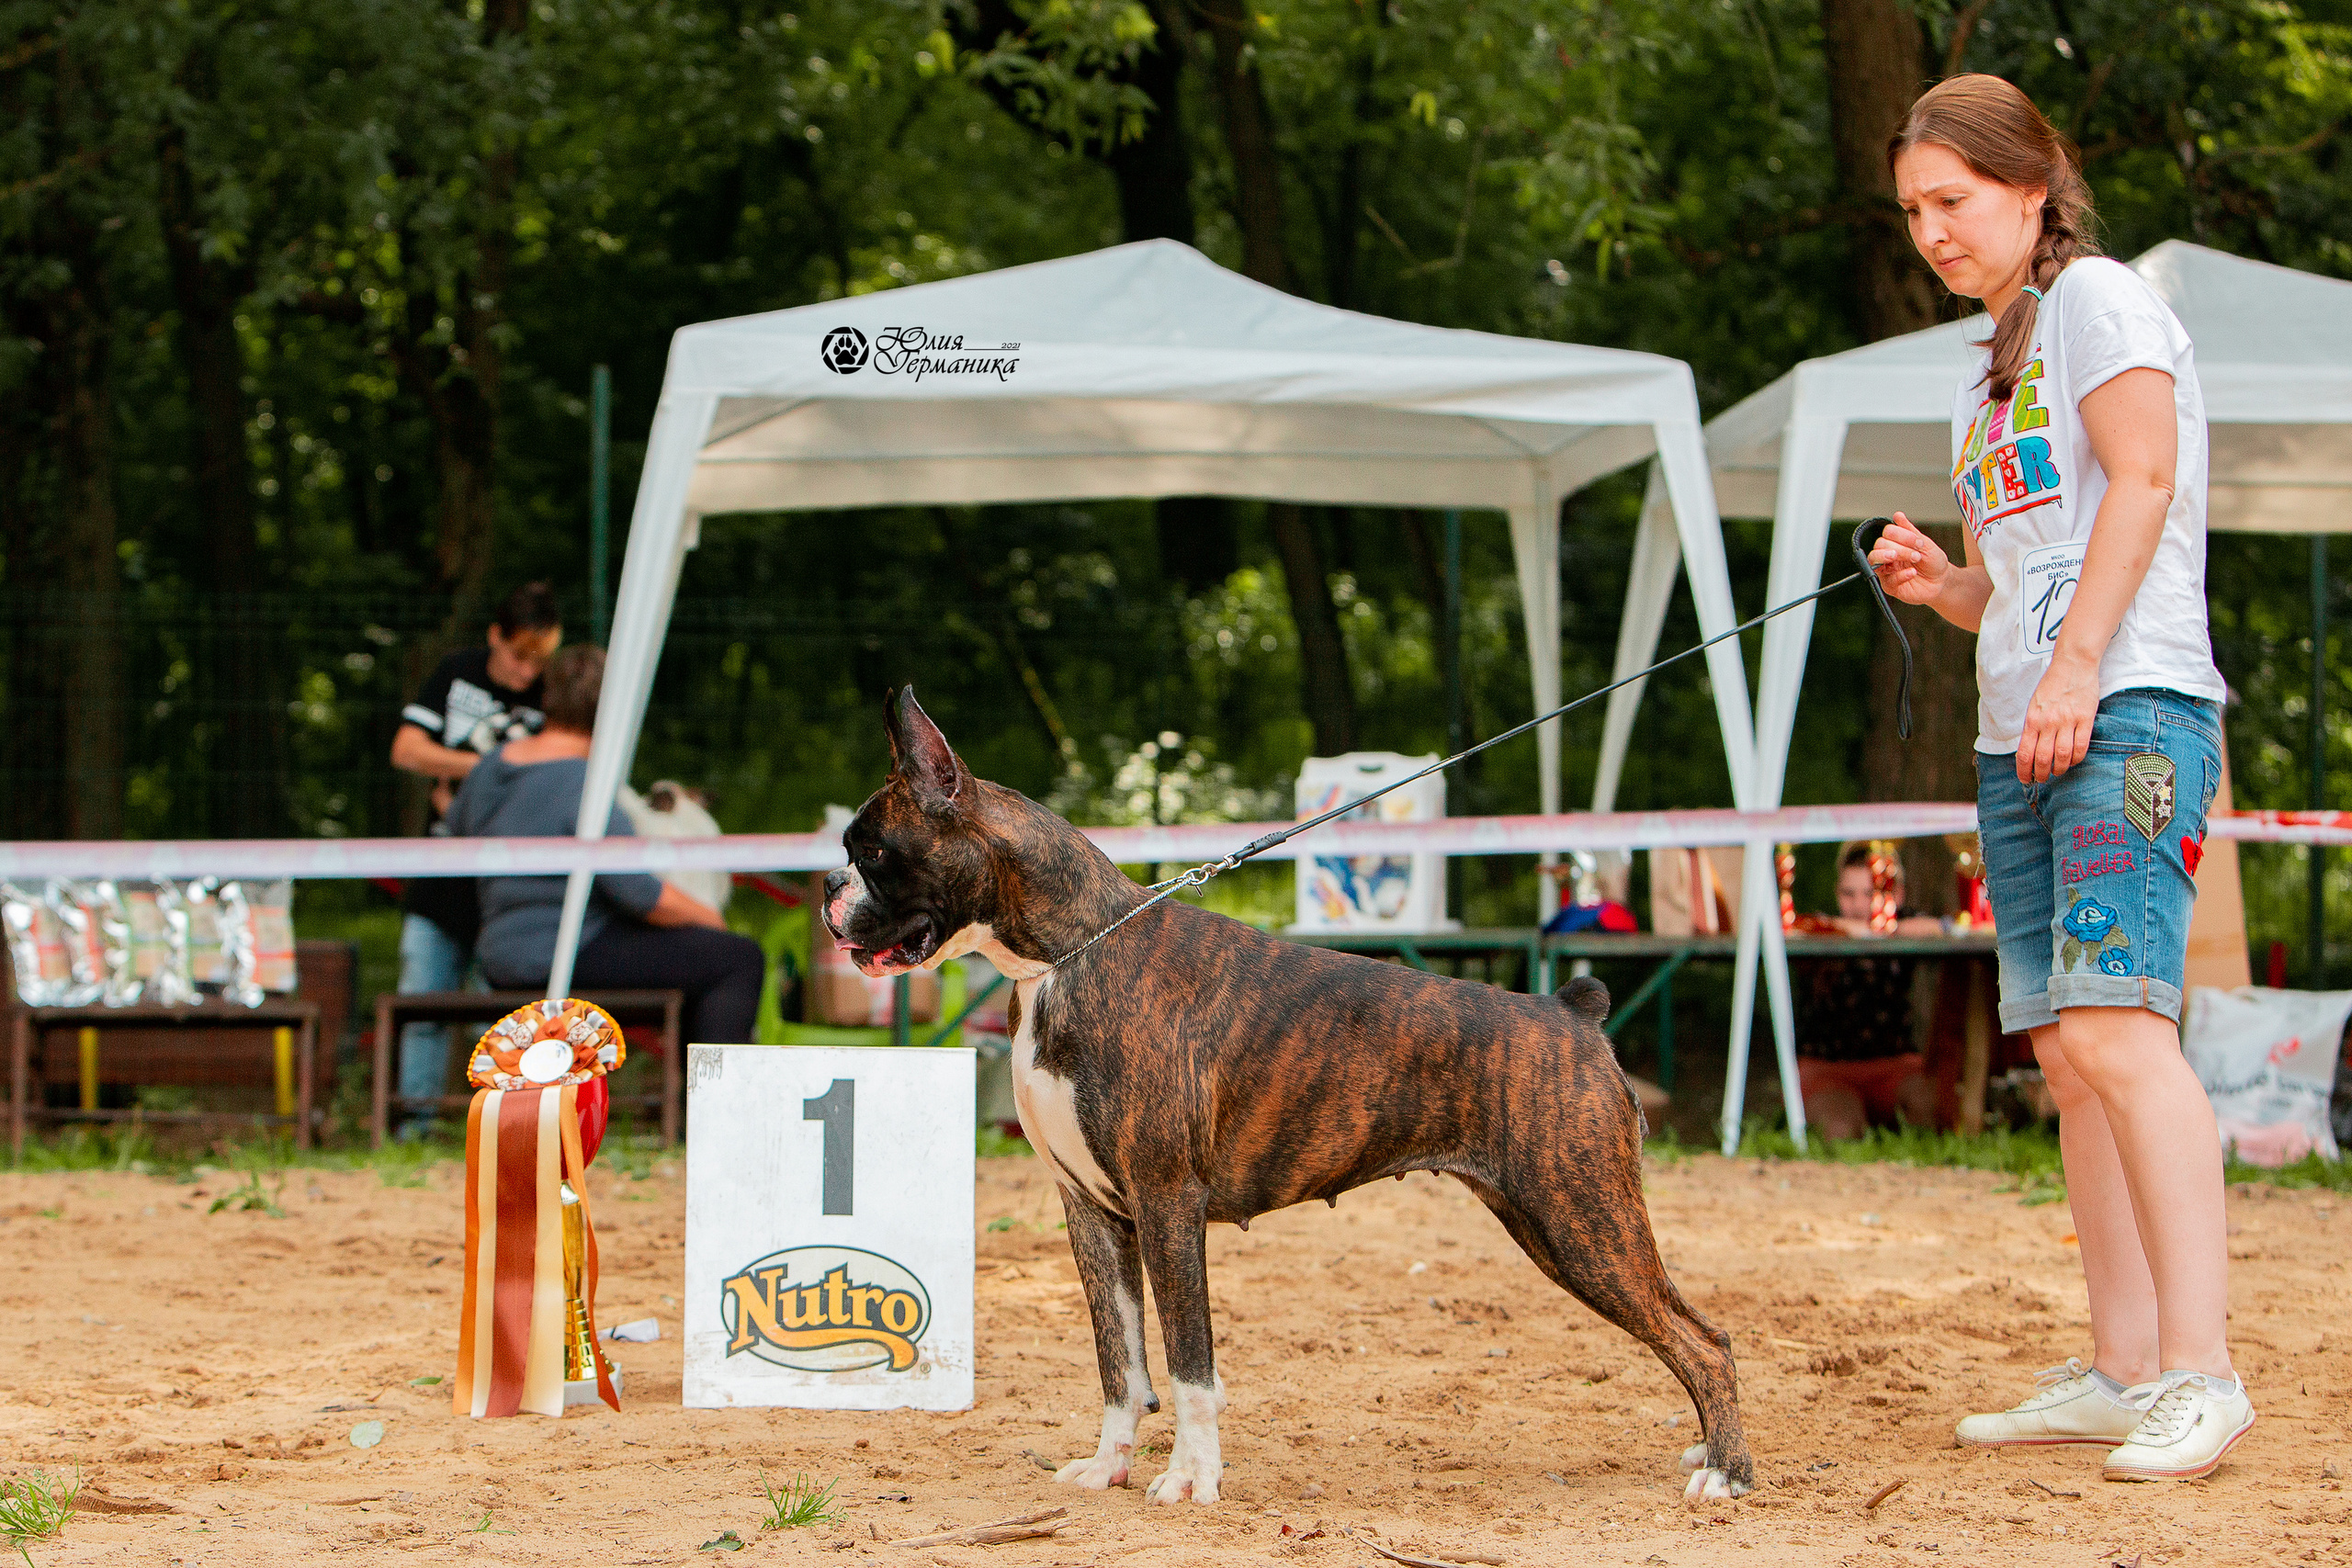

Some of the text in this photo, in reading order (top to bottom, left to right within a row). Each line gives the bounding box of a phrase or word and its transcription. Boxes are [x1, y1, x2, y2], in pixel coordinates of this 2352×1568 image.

[1953, 435, 2061, 532] INTER
[2047, 570, 2069, 581] БИС»
[802, 1077, 855, 1216] 1
[721, 1262, 922, 1359] Nutro
